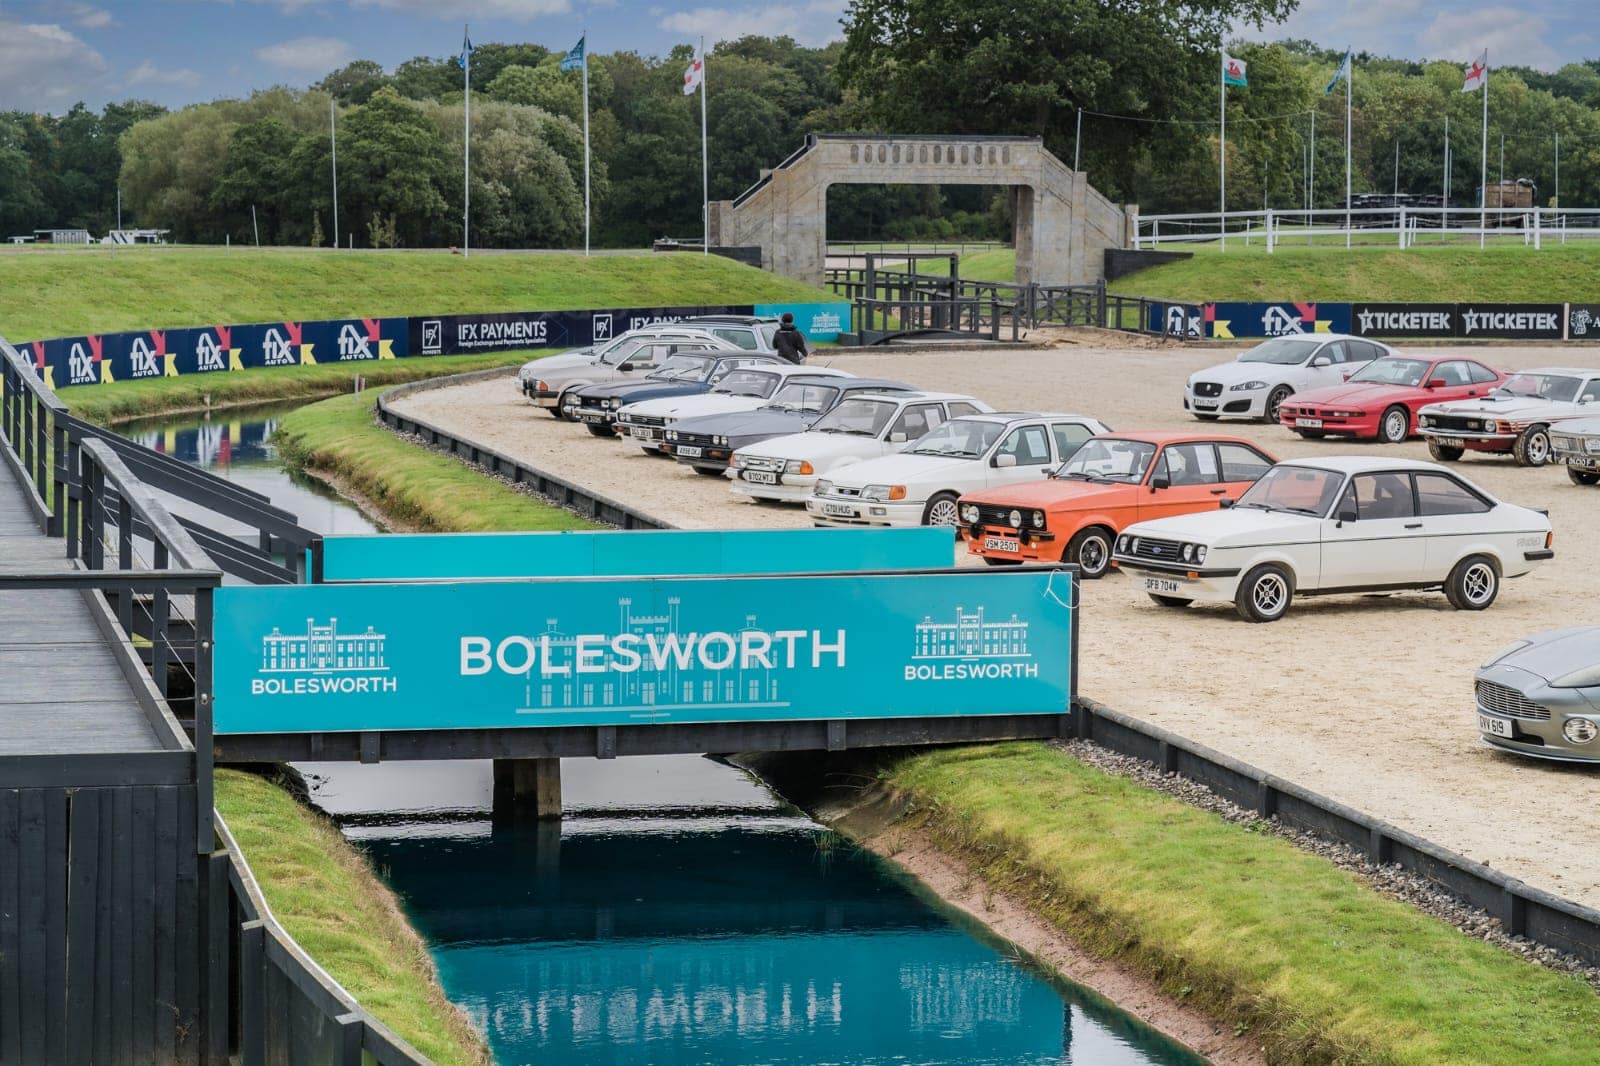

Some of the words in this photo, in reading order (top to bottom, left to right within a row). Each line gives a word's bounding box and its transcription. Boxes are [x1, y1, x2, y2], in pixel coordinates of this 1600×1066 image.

[1374, 312, 1450, 329] TICKETEK
[1479, 312, 1558, 330] TICKETEK
[458, 323, 478, 340] IFX
[480, 321, 547, 339] PAYMENTS
[196, 332, 225, 369] fix
[262, 328, 295, 363] fix
[338, 324, 373, 359] fix
[68, 342, 96, 382] fix
[130, 337, 160, 375] fix
[132, 369, 153, 377] AUTO
[986, 539, 999, 549] VSM
[1000, 541, 1017, 551] 250T
[460, 629, 846, 675] BOLESWORTH
[904, 663, 1038, 681] BOLESWORTH
[252, 677, 397, 695] BOLESWORTH
[1491, 719, 1504, 734] 619
